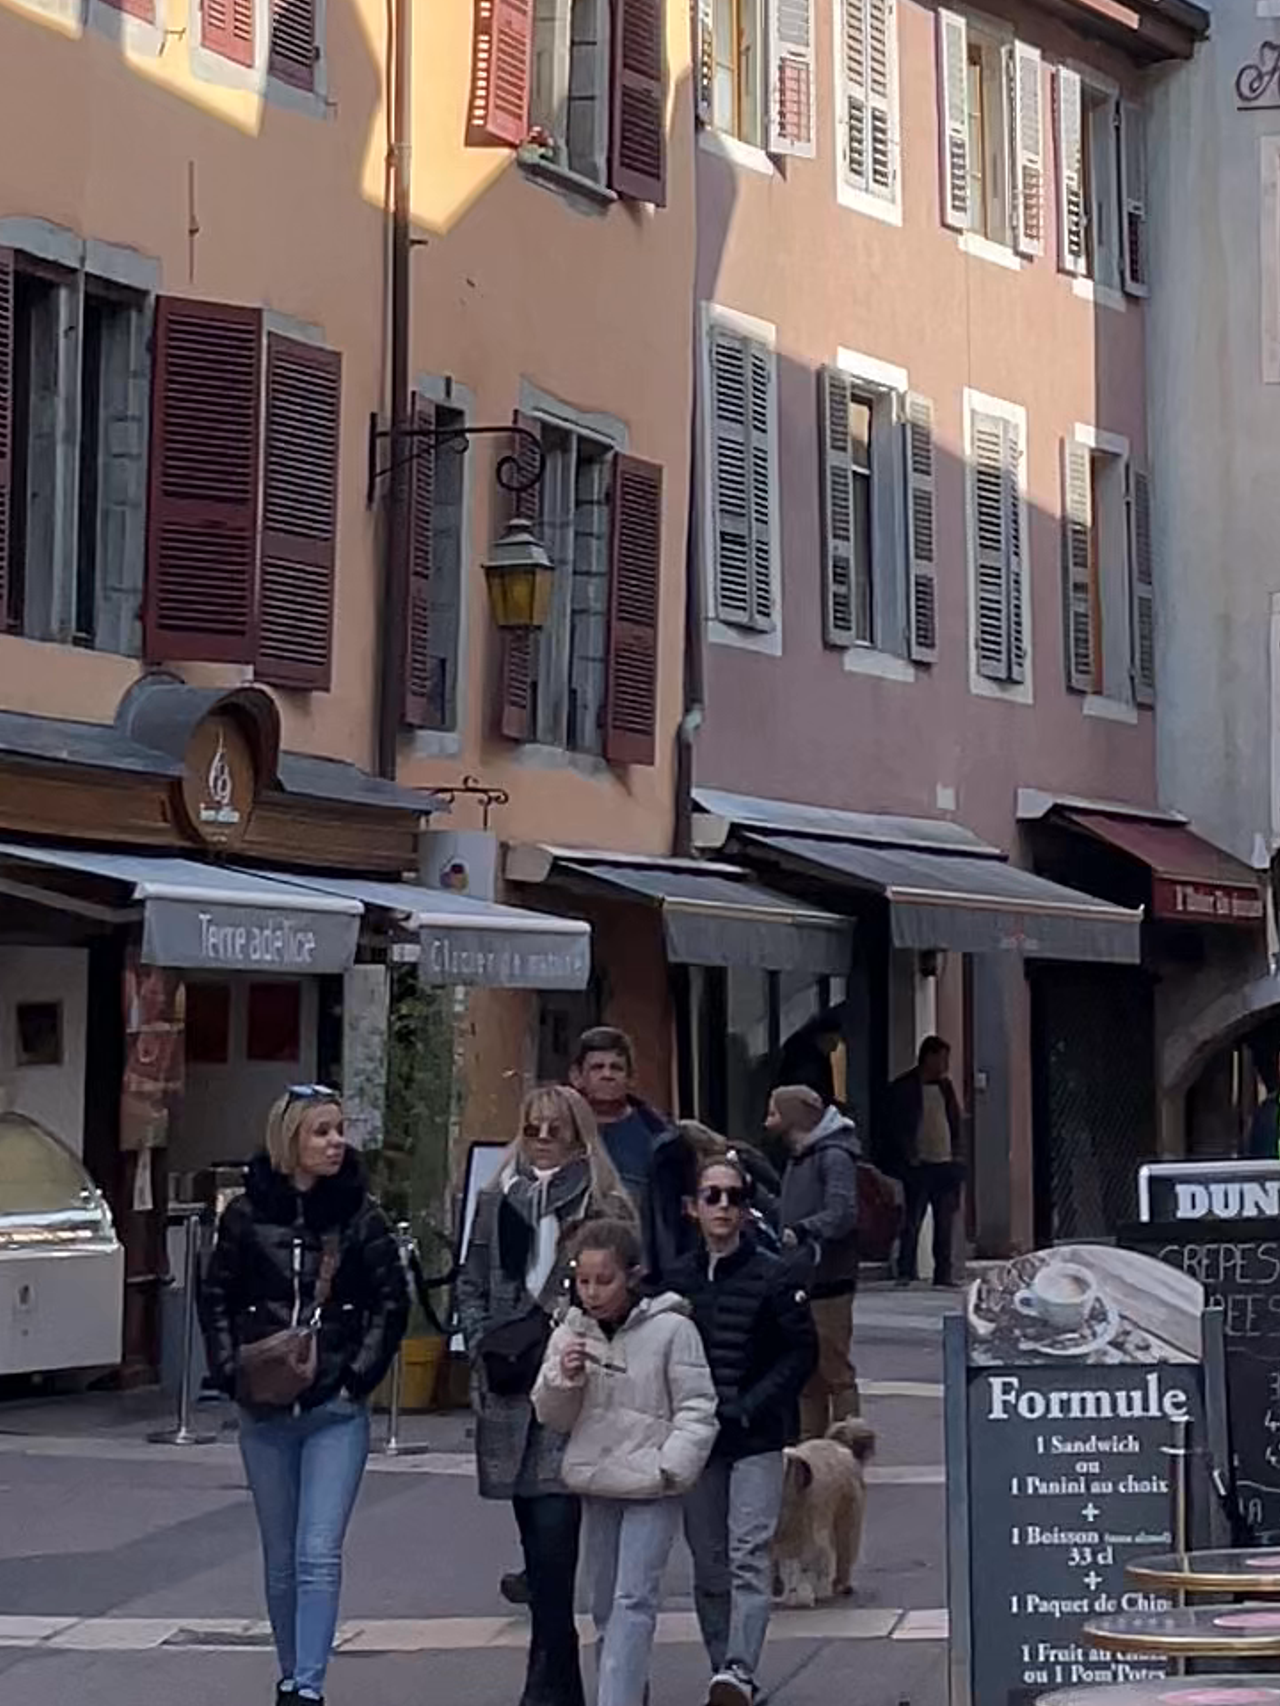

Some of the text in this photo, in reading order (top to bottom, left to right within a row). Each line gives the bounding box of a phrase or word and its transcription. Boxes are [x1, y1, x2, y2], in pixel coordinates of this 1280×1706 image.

[987, 1371, 1188, 1420] Formule
[1037, 1435, 1141, 1454] 1 Sandwich
[1075, 1461, 1100, 1474] ou
[1011, 1474, 1170, 1495] 1 Panini au choix
[1011, 1527, 1019, 1545] 1
[1026, 1526, 1100, 1545] Boisson
[1068, 1545, 1114, 1566] 33 cl
[1011, 1595, 1018, 1614] 1
[1026, 1593, 1090, 1618] Paquet
[1094, 1592, 1118, 1613] de
[1022, 1644, 1030, 1662] 1
[1037, 1643, 1083, 1662] Fruit
[1088, 1648, 1111, 1662] au
[1023, 1668, 1048, 1683] ou
[1055, 1666, 1063, 1683] 1
